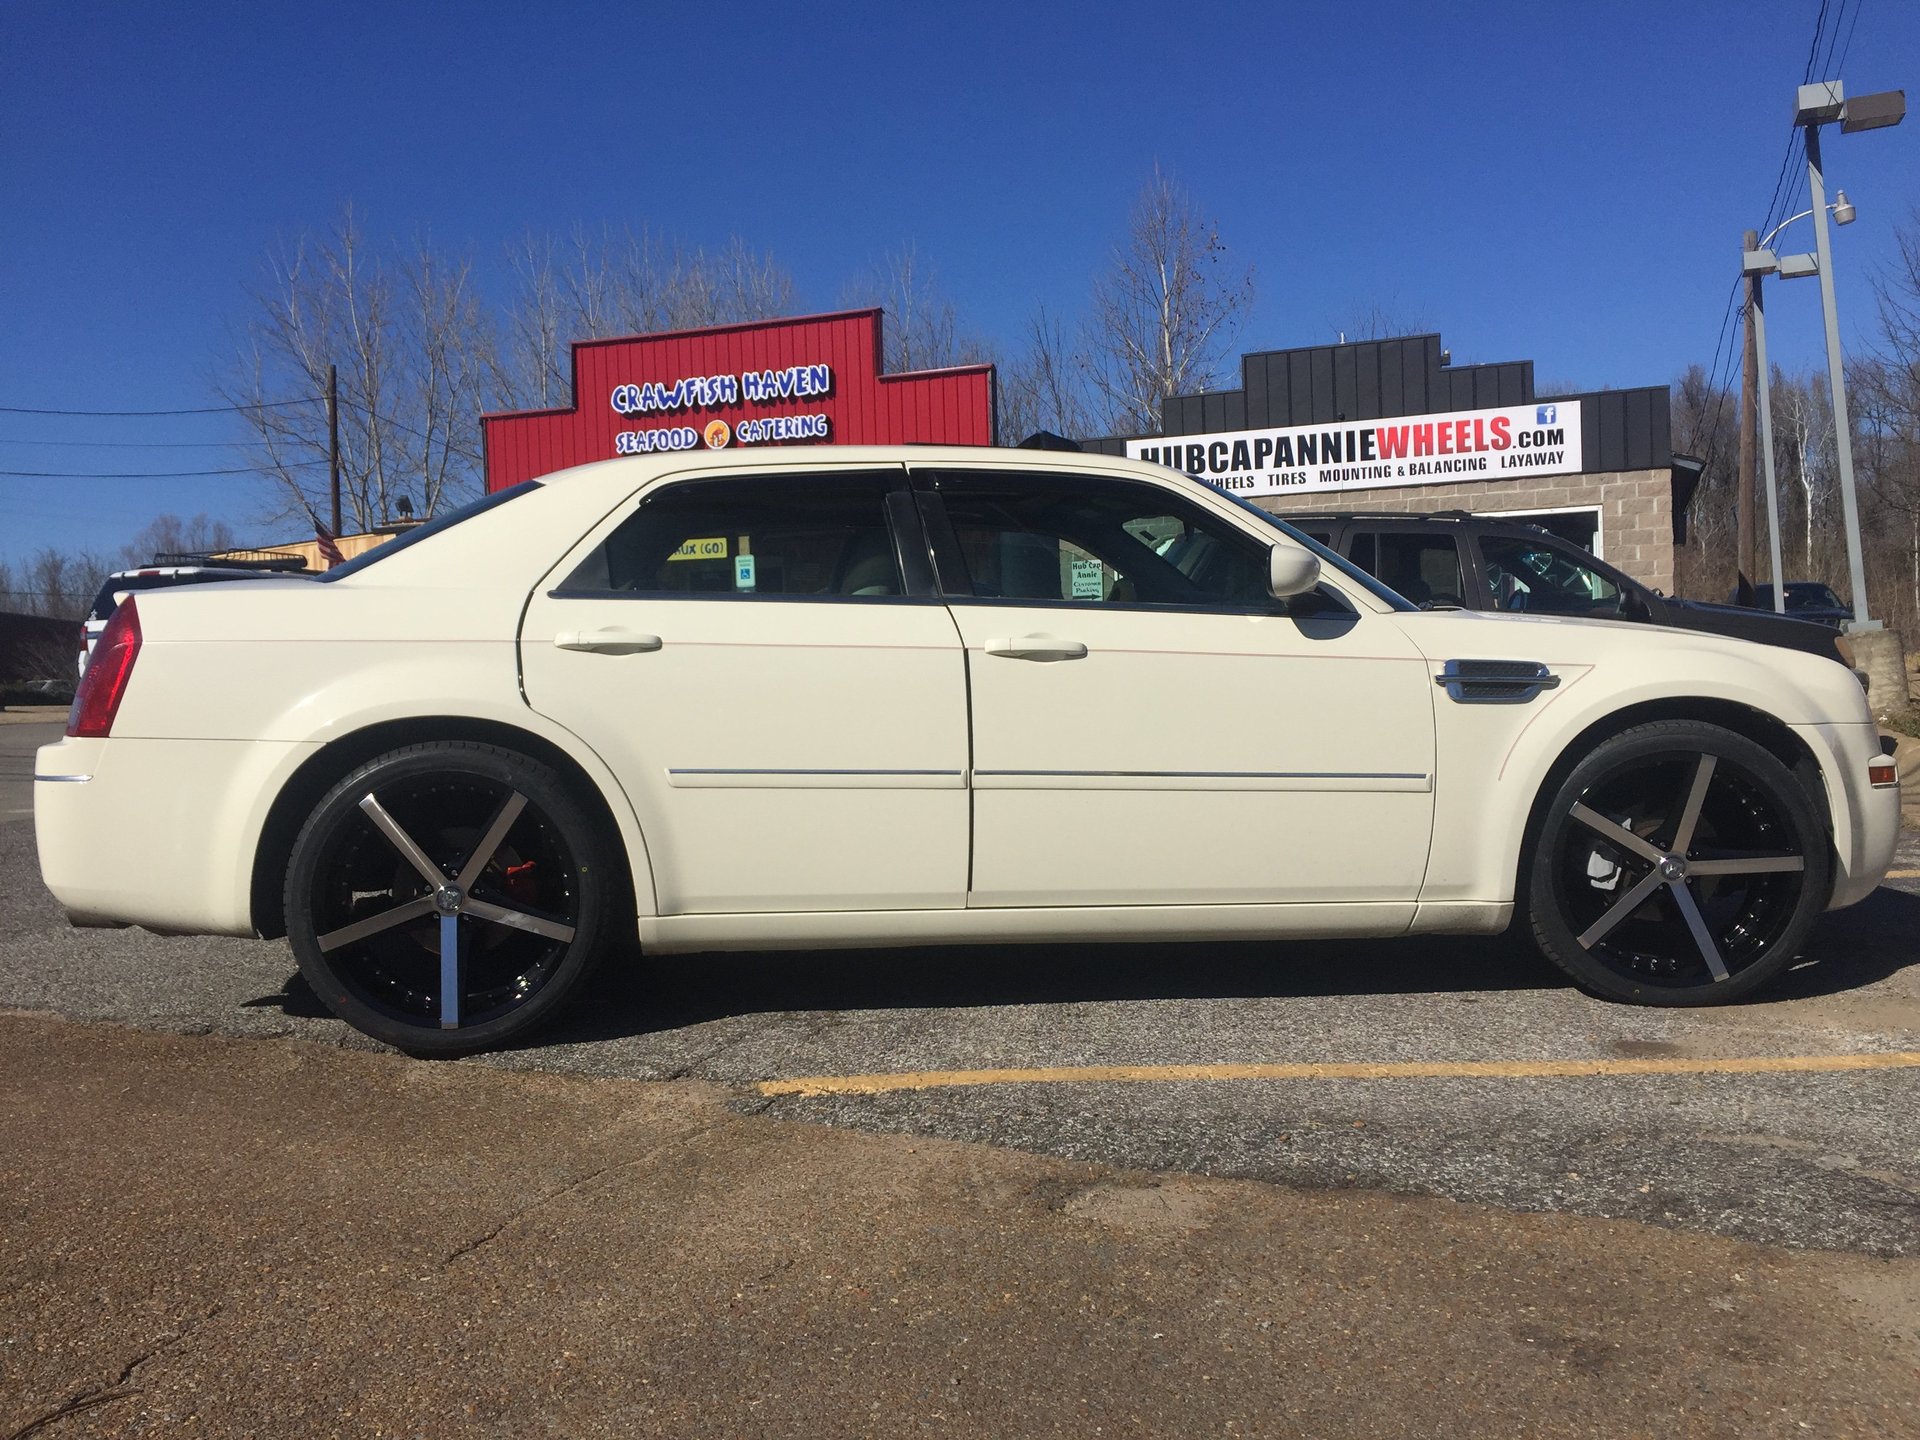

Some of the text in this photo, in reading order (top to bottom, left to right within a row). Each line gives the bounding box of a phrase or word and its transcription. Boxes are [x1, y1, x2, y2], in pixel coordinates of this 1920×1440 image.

[611, 364, 829, 413] CRAWFISH HAVEN
[616, 414, 827, 453] SEAFOOD CATERING
[1267, 471, 1307, 487] TIRES
[1319, 465, 1392, 482] MOUNTING
[1397, 467, 1405, 477] &
[1409, 457, 1487, 476] BALANCING
[1501, 451, 1564, 469] LAYAWAY
